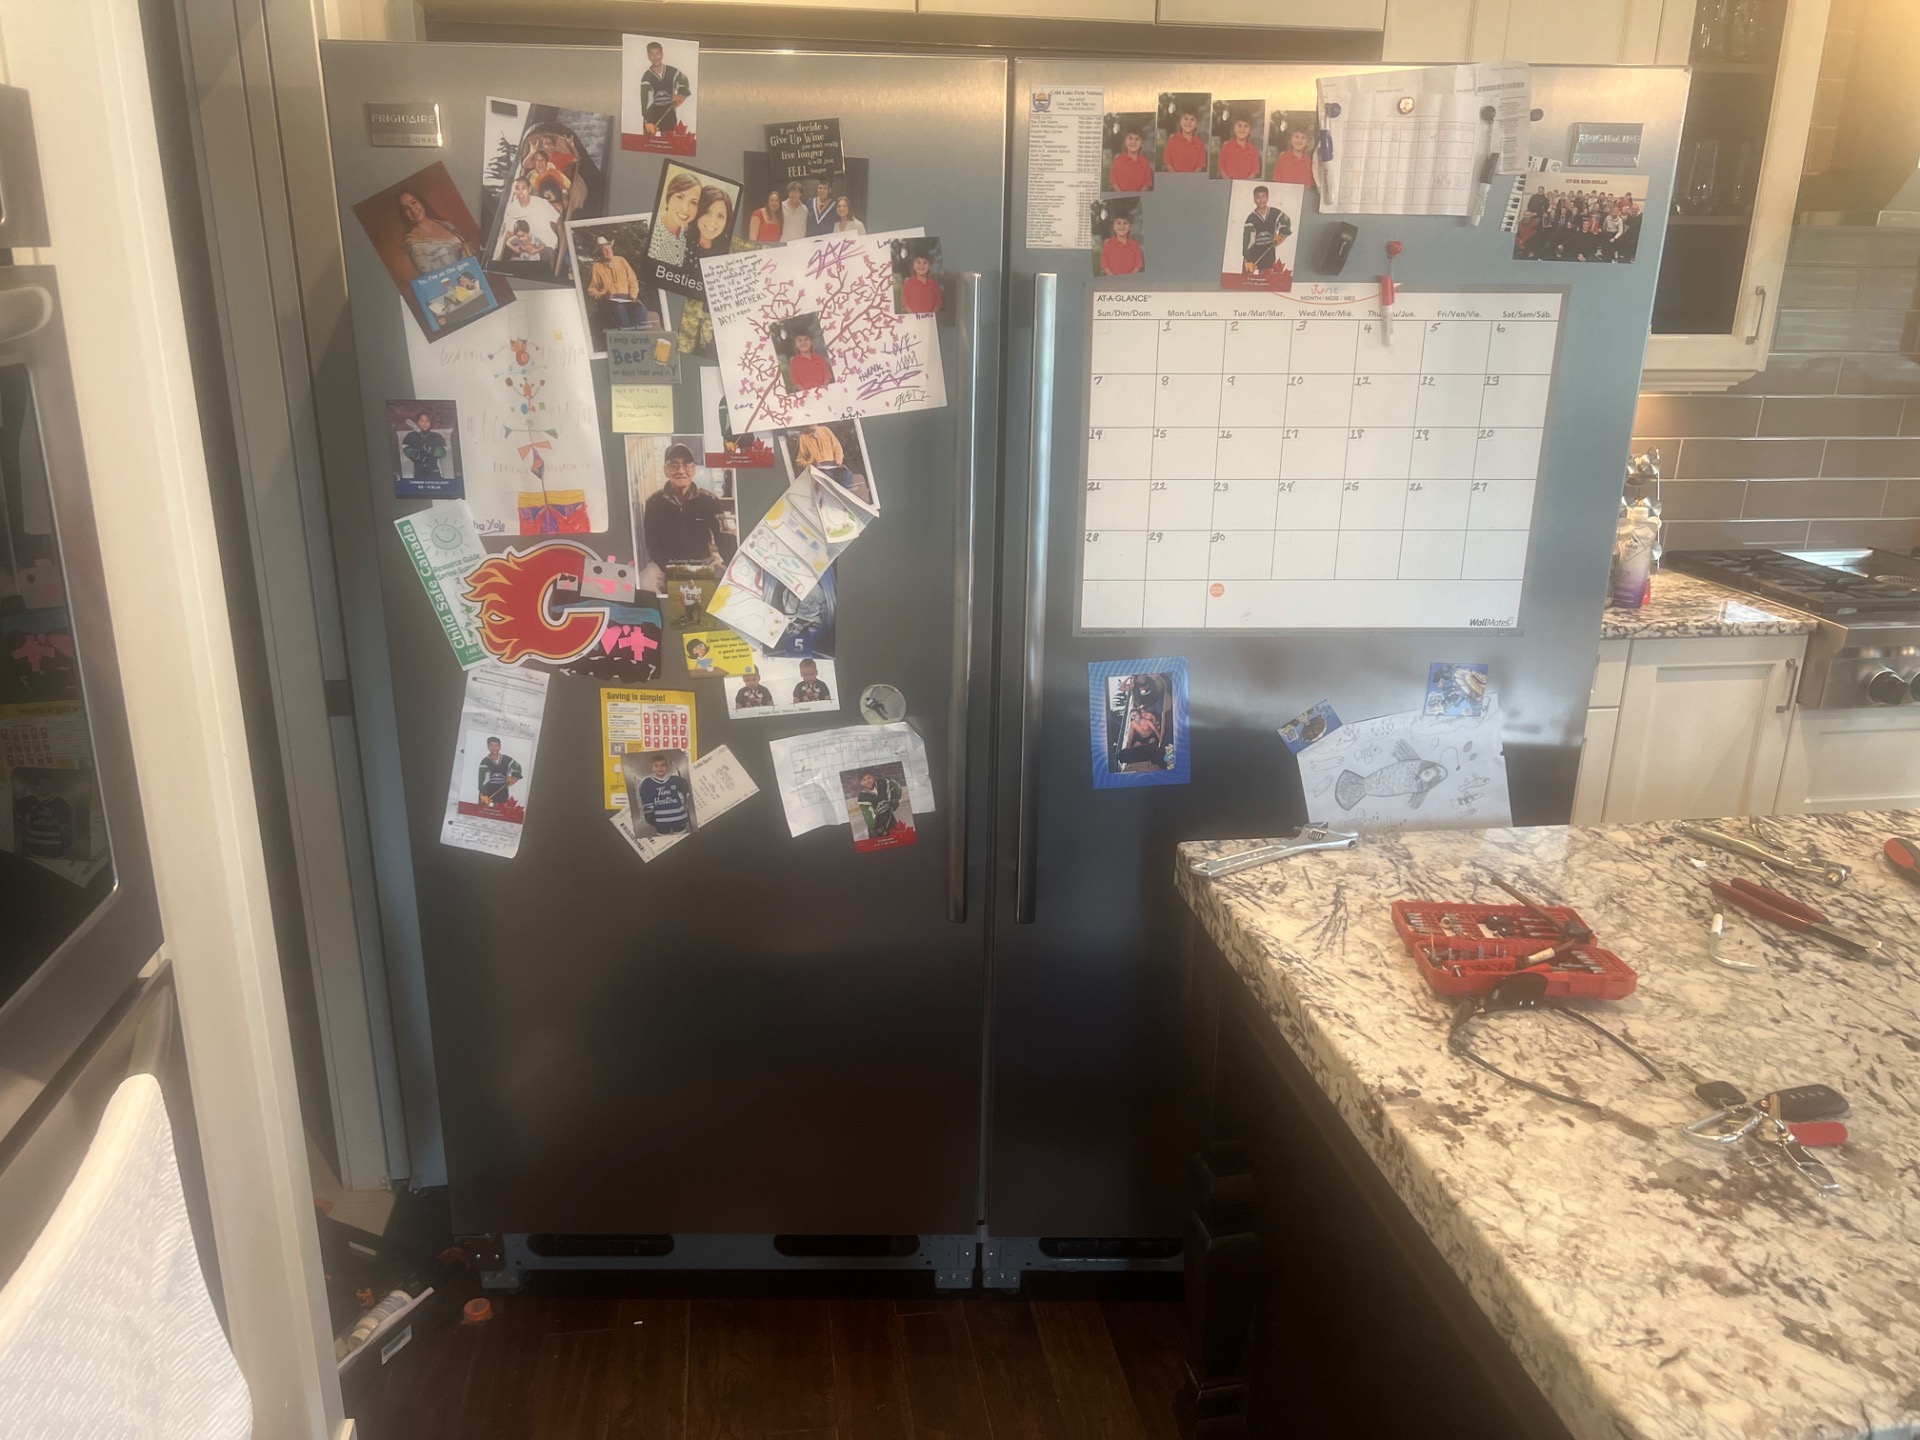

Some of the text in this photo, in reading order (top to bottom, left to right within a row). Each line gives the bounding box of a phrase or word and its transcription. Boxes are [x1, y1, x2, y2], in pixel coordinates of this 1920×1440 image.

[371, 113, 436, 124] FRIGIDAIRE
[797, 122, 822, 133] decide
[770, 132, 825, 147] Give Up Wine
[1578, 134, 1641, 144] FRIGIDAIRE
[781, 149, 824, 160] live longer
[787, 165, 810, 178] FEEL
[656, 265, 703, 291] Besties
[1311, 284, 1340, 295] June
[713, 292, 767, 312] HAPPY MOTHERS
[1097, 309, 1153, 318] Sun/Dim/Dom.
[1167, 309, 1220, 318] Mon/Lun/Lun.
[1233, 309, 1286, 318] Tue/Mar/Mar.
[1298, 309, 1355, 318] Wed/Mer/Mié.
[1437, 310, 1482, 319] Fri/Ven/Vie.
[1502, 310, 1553, 319] Sat/Sam/Sáb.
[1163, 321, 1506, 334] 1 2 3 4 5 6
[613, 335, 629, 345] only
[631, 334, 651, 345] drink
[611, 348, 648, 366] Beer
[670, 364, 677, 376] Y
[1094, 376, 1103, 386] 7
[1161, 376, 1169, 386] 8
[1227, 376, 1236, 386] 9
[1287, 376, 1304, 386] 10
[1421, 376, 1436, 387] 12
[1484, 375, 1500, 386] 13
[734, 402, 754, 410] care
[1089, 428, 1494, 441] 14 15 16 17 18 19 20
[1087, 481, 1488, 492] 21 22 23 24 25 26 27
[1085, 532, 1226, 543] 28 29 30
[433, 552, 482, 573] Resource Guide
[402, 524, 466, 649] Child Safe Canada
[1469, 617, 1510, 627] WallMates
[794, 639, 804, 651] 5
[606, 692, 666, 703] Saving is simple!
